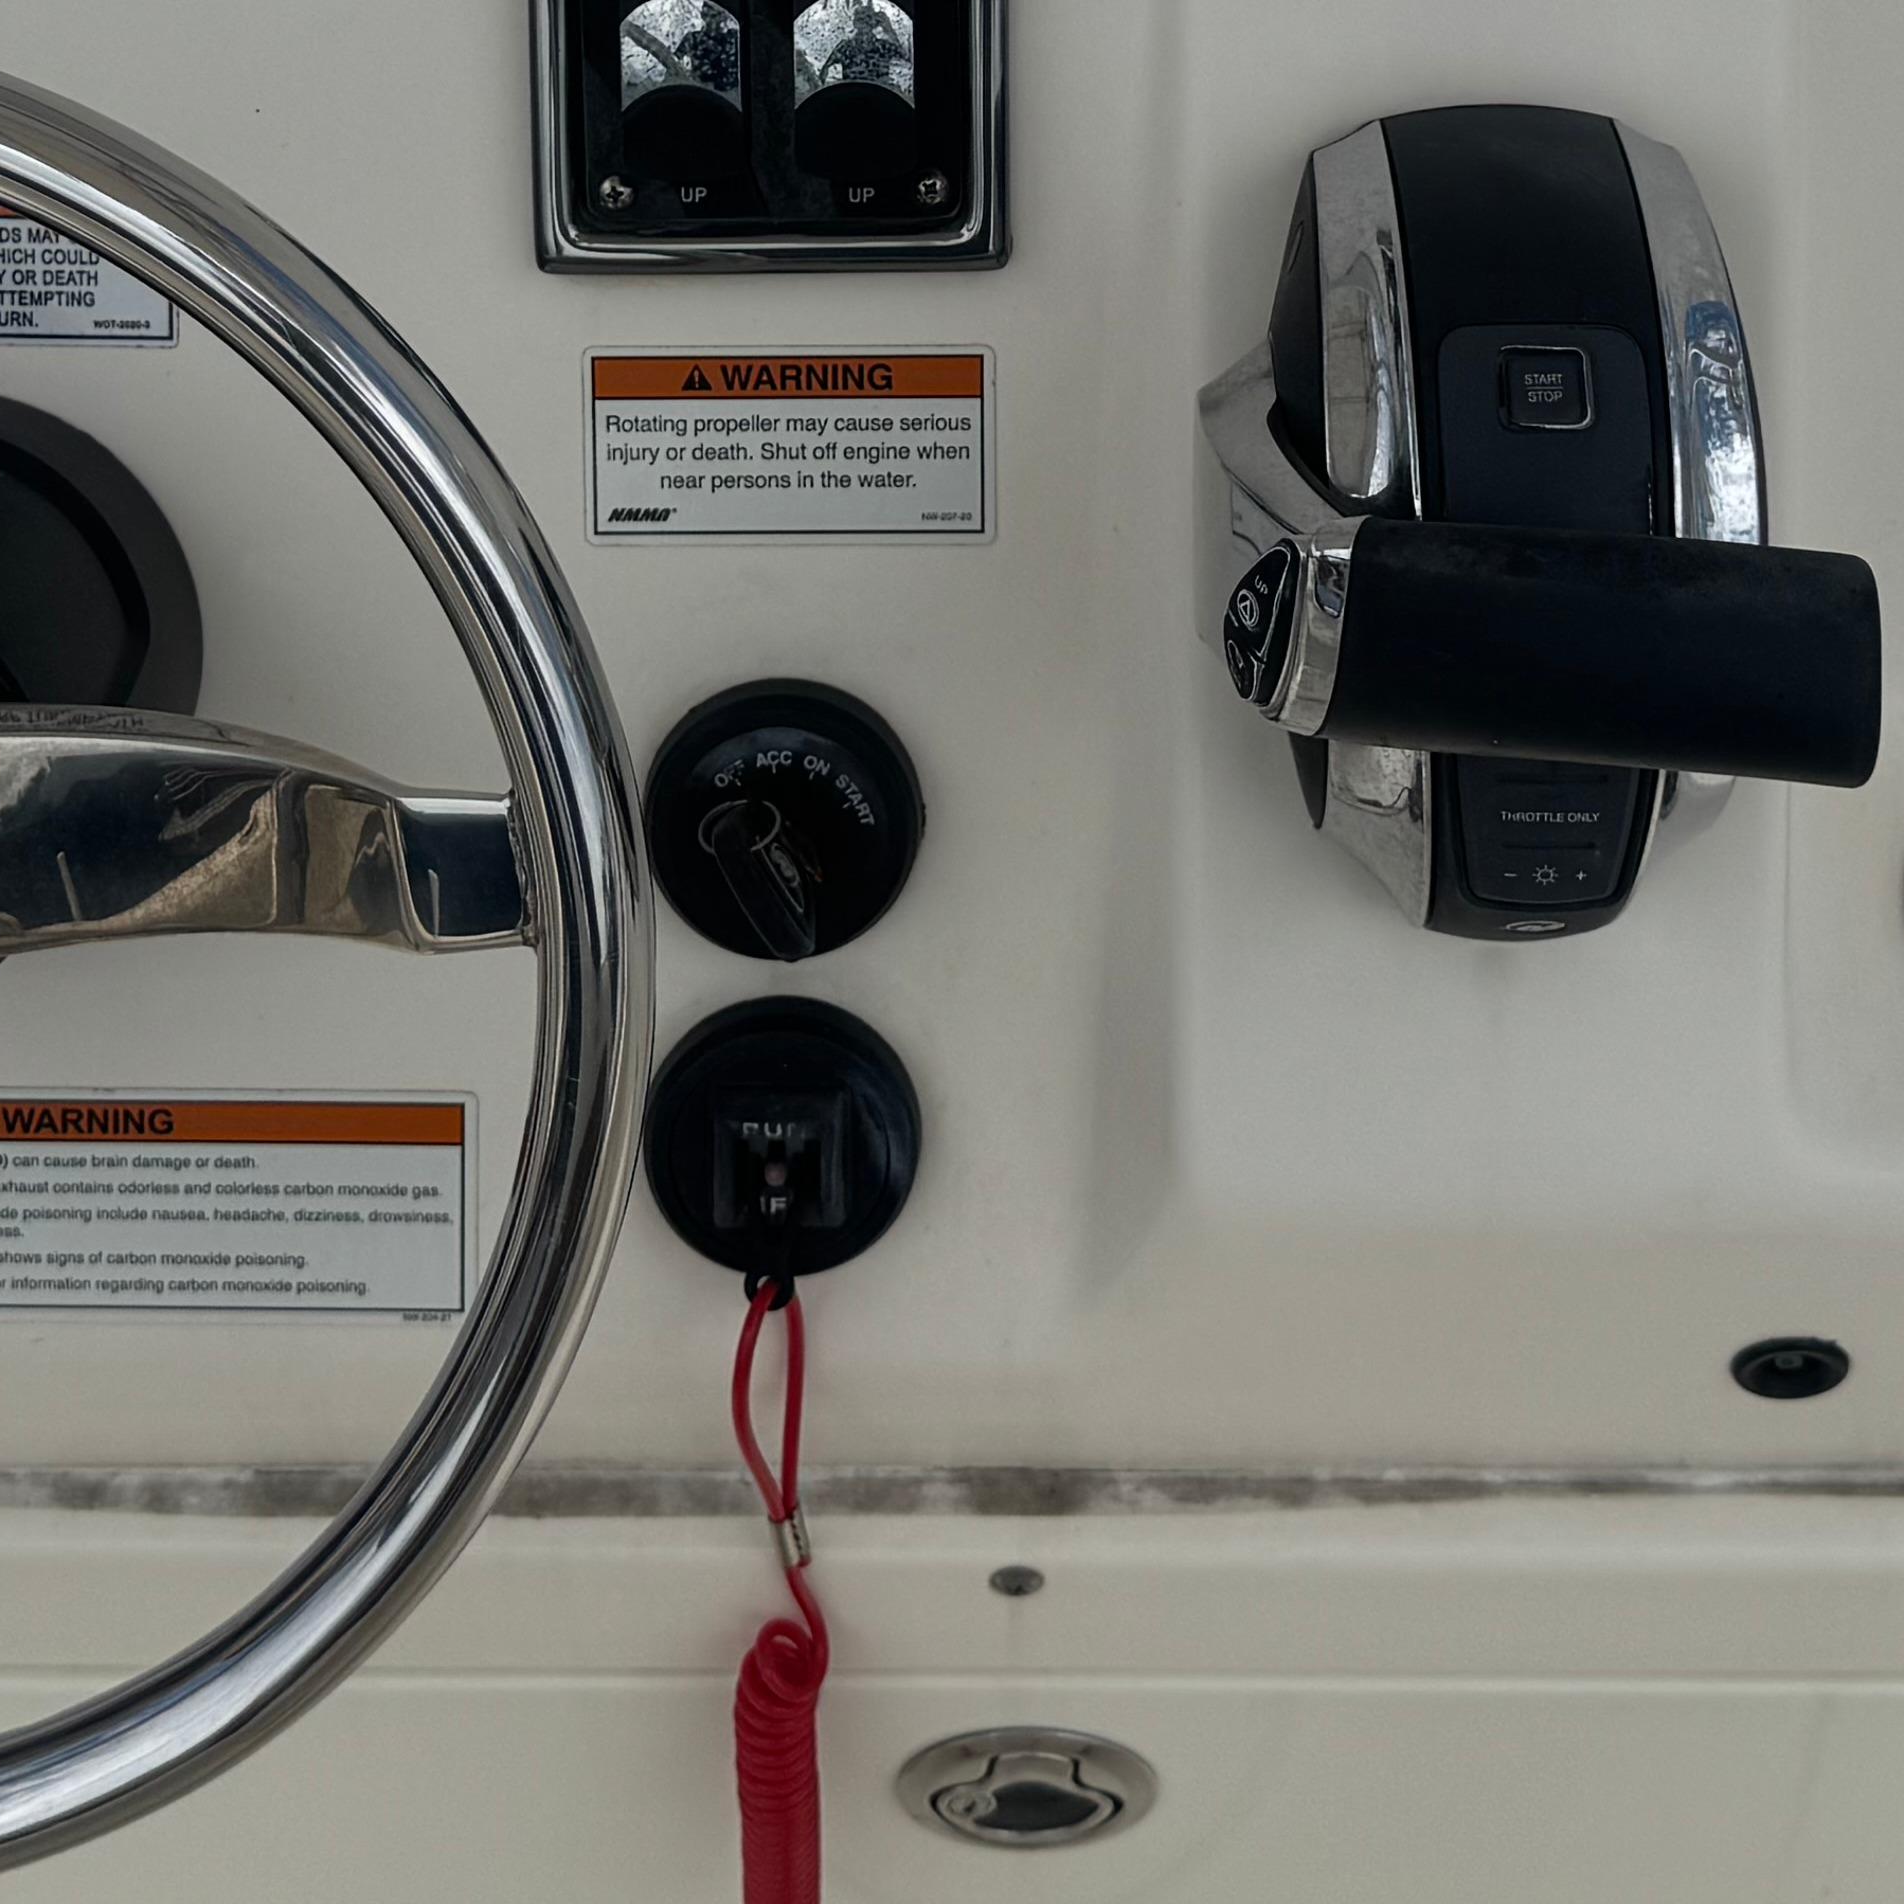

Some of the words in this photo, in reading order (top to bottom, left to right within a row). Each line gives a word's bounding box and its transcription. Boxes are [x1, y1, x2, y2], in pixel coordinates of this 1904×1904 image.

[682, 187, 708, 204] UP
[849, 188, 876, 204] UP
[40, 248, 100, 266] COULD
[11, 268, 37, 285] OR
[42, 269, 98, 286] DEATH
[720, 363, 894, 392] WARNING
[1524, 373, 1563, 386] START
[1528, 390, 1564, 403] STOP
[606, 414, 687, 437] Rotating
[694, 414, 781, 437] propeller
[786, 417, 828, 437] may
[833, 417, 894, 432] cause
[899, 413, 971, 432] serious
[607, 443, 660, 465] injury
[665, 447, 686, 461] or
[691, 442, 753, 461] death.
[760, 441, 807, 460] Shut
[812, 441, 837, 460] off
[843, 441, 910, 464] engine
[916, 441, 970, 460] when
[660, 475, 705, 489] near
[711, 474, 791, 493] persons
[797, 470, 814, 488] in
[820, 470, 851, 488] the
[857, 471, 916, 488] water.
[756, 750, 793, 768] ACC
[803, 755, 831, 776] ON
[835, 774, 876, 826] START
[1501, 811, 1564, 824] THROTTLE
[1567, 812, 1600, 824] ONLY
[3, 1107, 175, 1137] WARNING
[12, 1156, 39, 1167] can
[43, 1156, 87, 1168] cause
[91, 1154, 128, 1168] brain
[131, 1154, 191, 1171] damage
[195, 1157, 209, 1168] or
[52, 1181, 114, 1194] contains
[117, 1181, 180, 1195] odorless
[183, 1182, 211, 1195] and
[215, 1181, 280, 1196] colorless
[283, 1182, 333, 1196] carbon
[337, 1183, 408, 1197] monoxide
[21, 1208, 92, 1223] poisoning
[95, 1206, 147, 1221] include
[151, 1209, 209, 1221] nausea,
[213, 1207, 288, 1222] headache,
[293, 1209, 364, 1223] dizziness,
[368, 1209, 453, 1224] drowsiness,
[46, 1252, 84, 1268] signs
[88, 1250, 102, 1264] of
[106, 1252, 156, 1265] carbon
[160, 1252, 231, 1266] monoxide
[10, 1276, 91, 1290] information
[95, 1277, 164, 1294] regarding
[167, 1278, 218, 1293] carbon
[221, 1279, 293, 1292] monoxide
